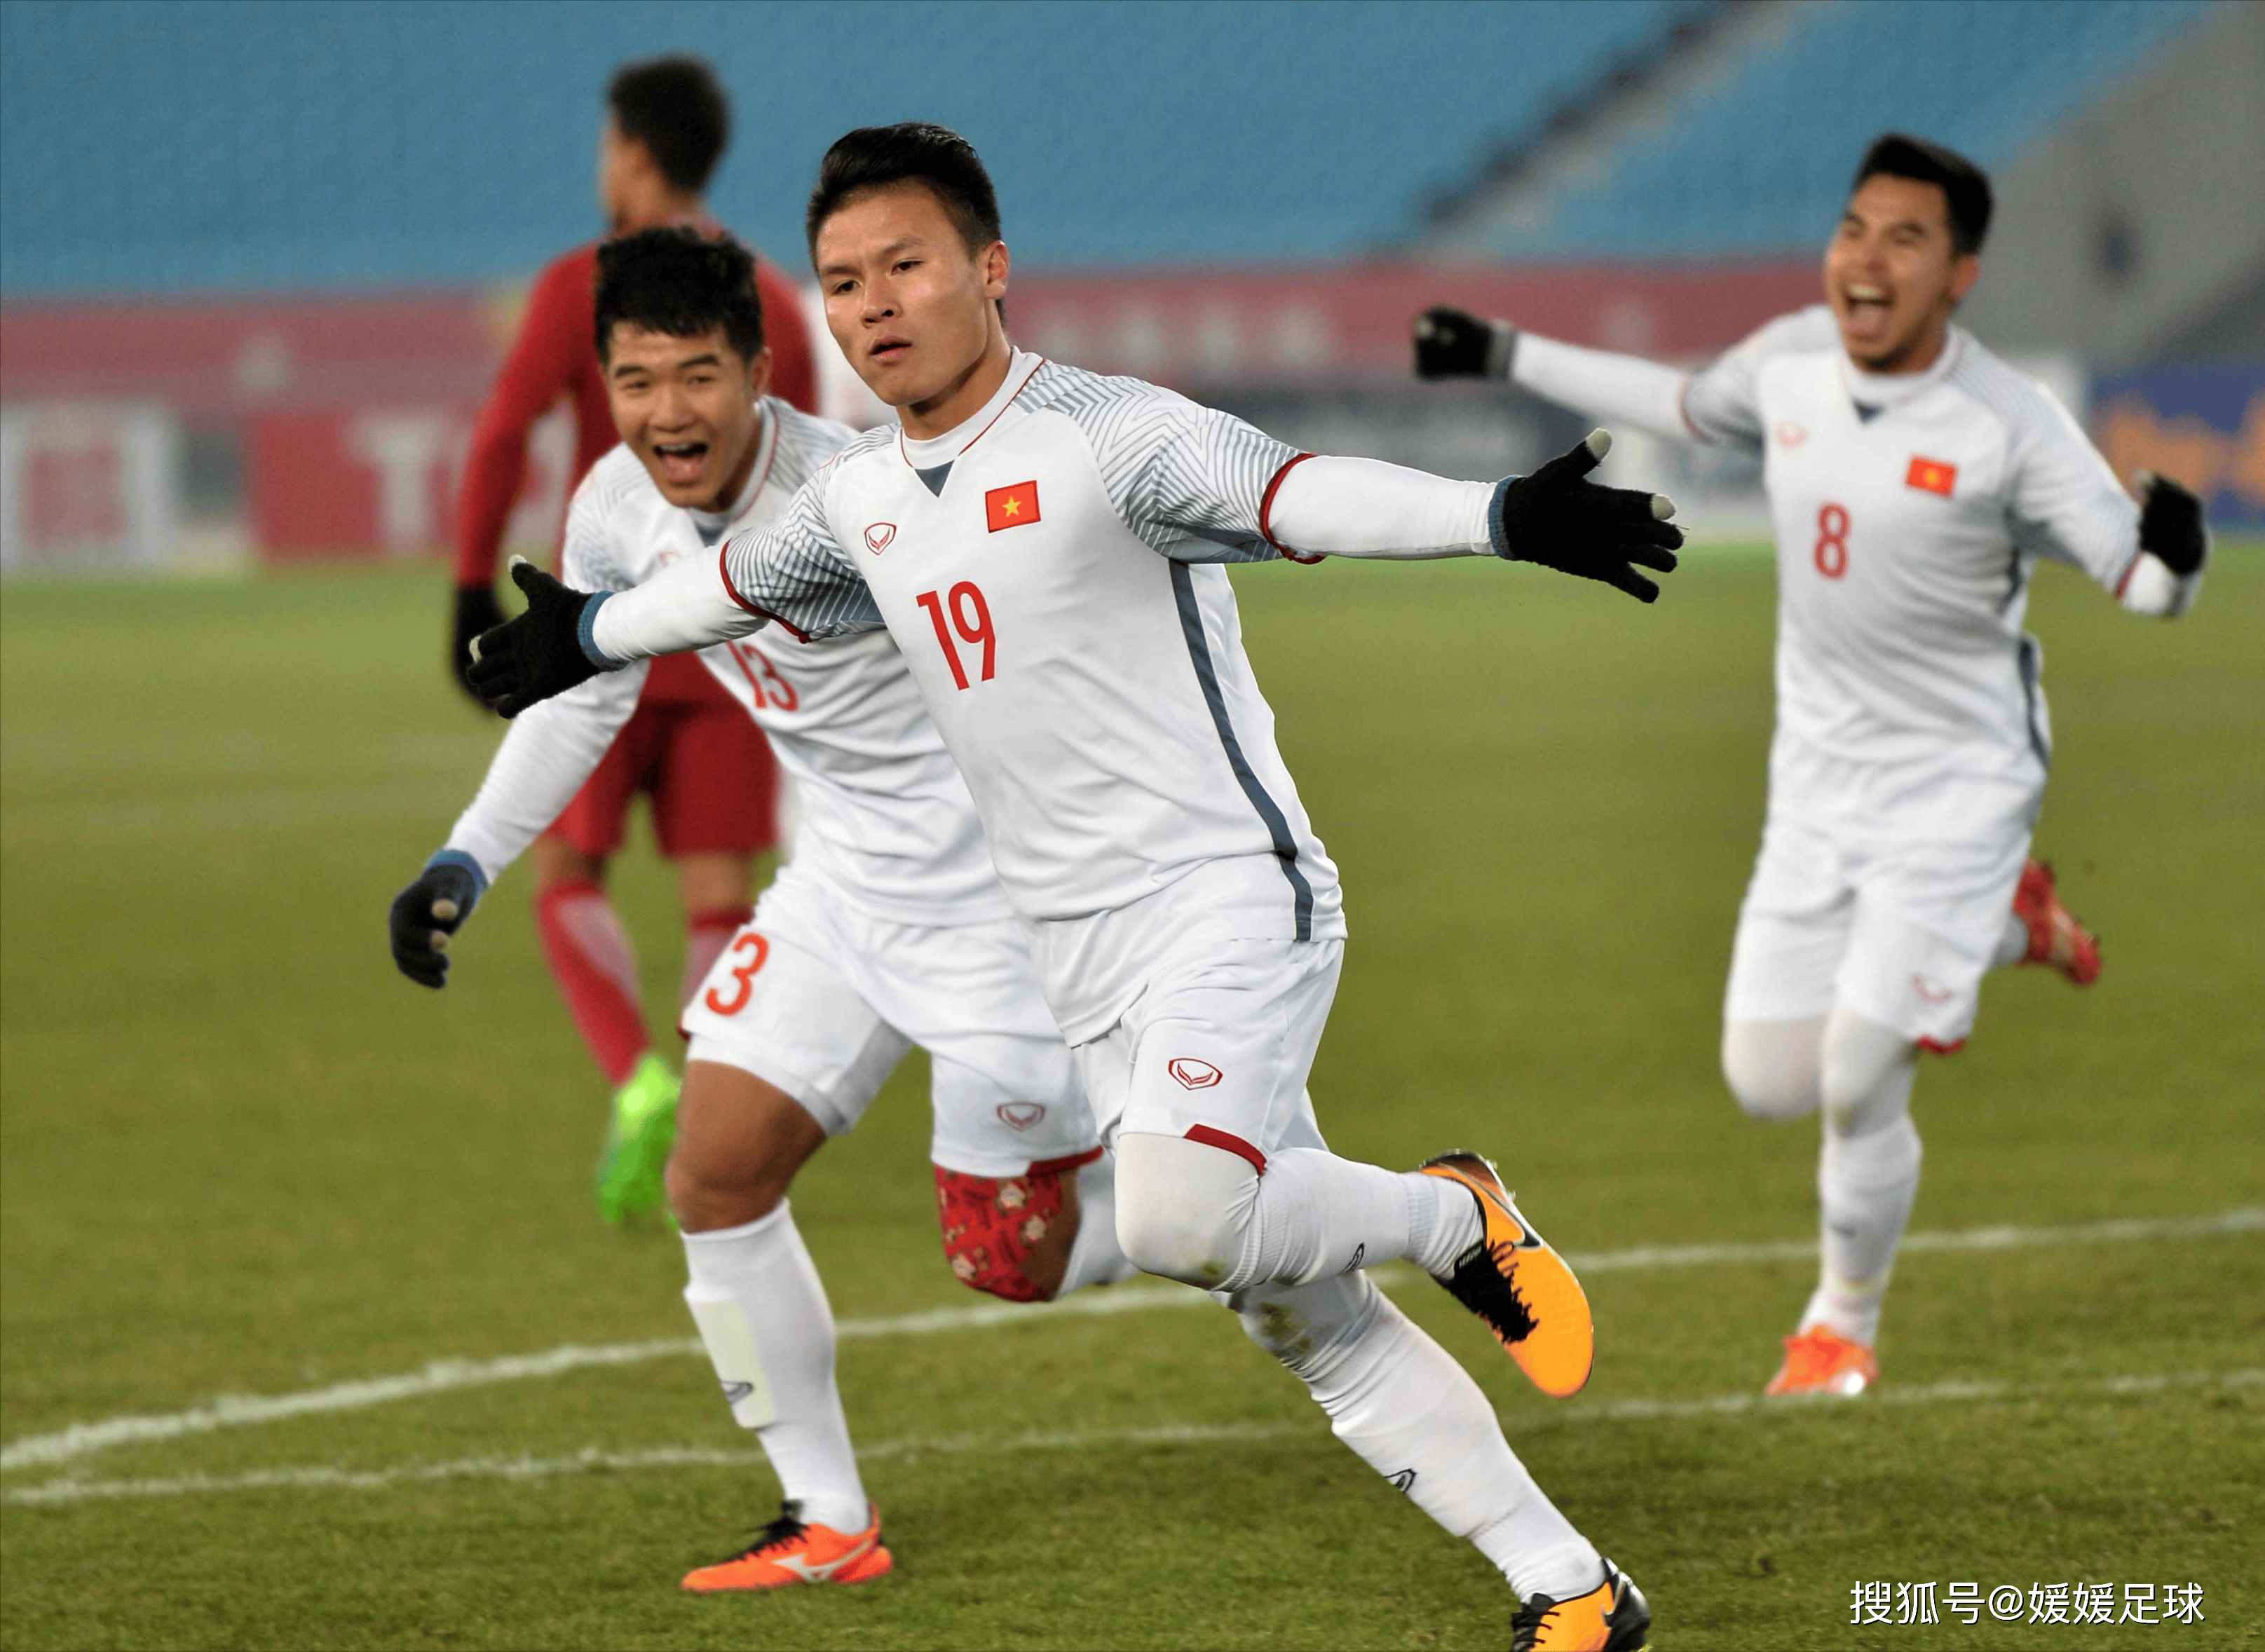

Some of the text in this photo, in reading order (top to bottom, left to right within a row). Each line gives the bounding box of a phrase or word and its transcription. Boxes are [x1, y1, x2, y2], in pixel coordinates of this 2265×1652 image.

[1813, 501, 1852, 581] 8
[726, 638, 799, 712] 13
[916, 580, 997, 691] 19
[704, 931, 770, 1018] 3
